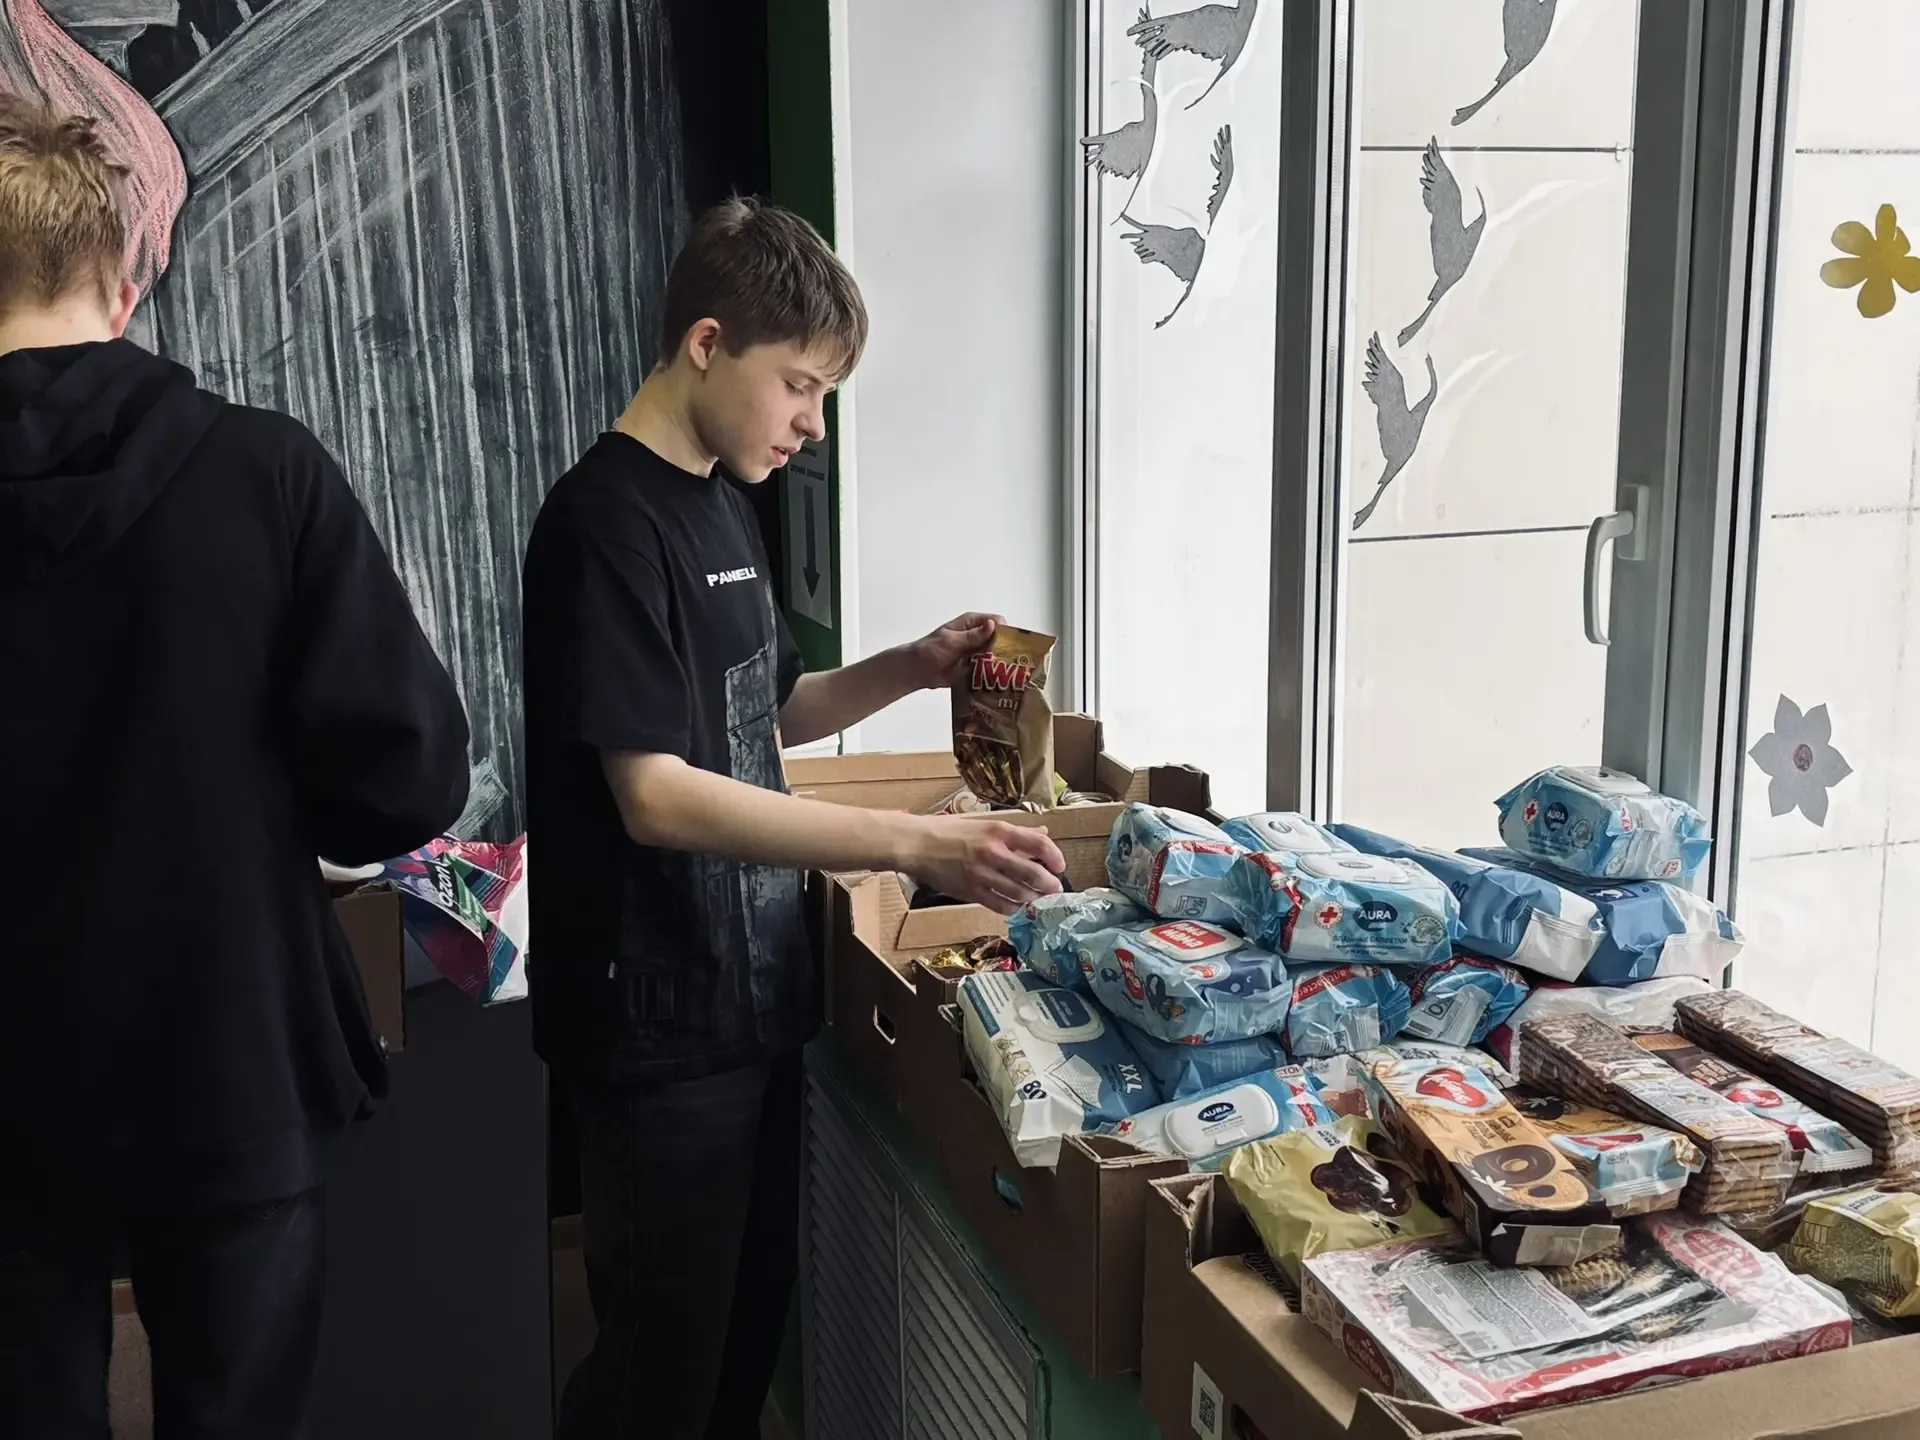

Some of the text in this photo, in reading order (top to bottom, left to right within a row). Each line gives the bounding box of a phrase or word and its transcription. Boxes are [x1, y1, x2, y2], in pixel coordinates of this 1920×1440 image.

[971, 651, 1035, 691] Twi
[1546, 810, 1565, 821] AURA
[1358, 909, 1392, 921] AURA
[1118, 1063, 1142, 1094] XXL
[1023, 1080, 1047, 1100] 80
[1202, 1105, 1231, 1118] AURA
